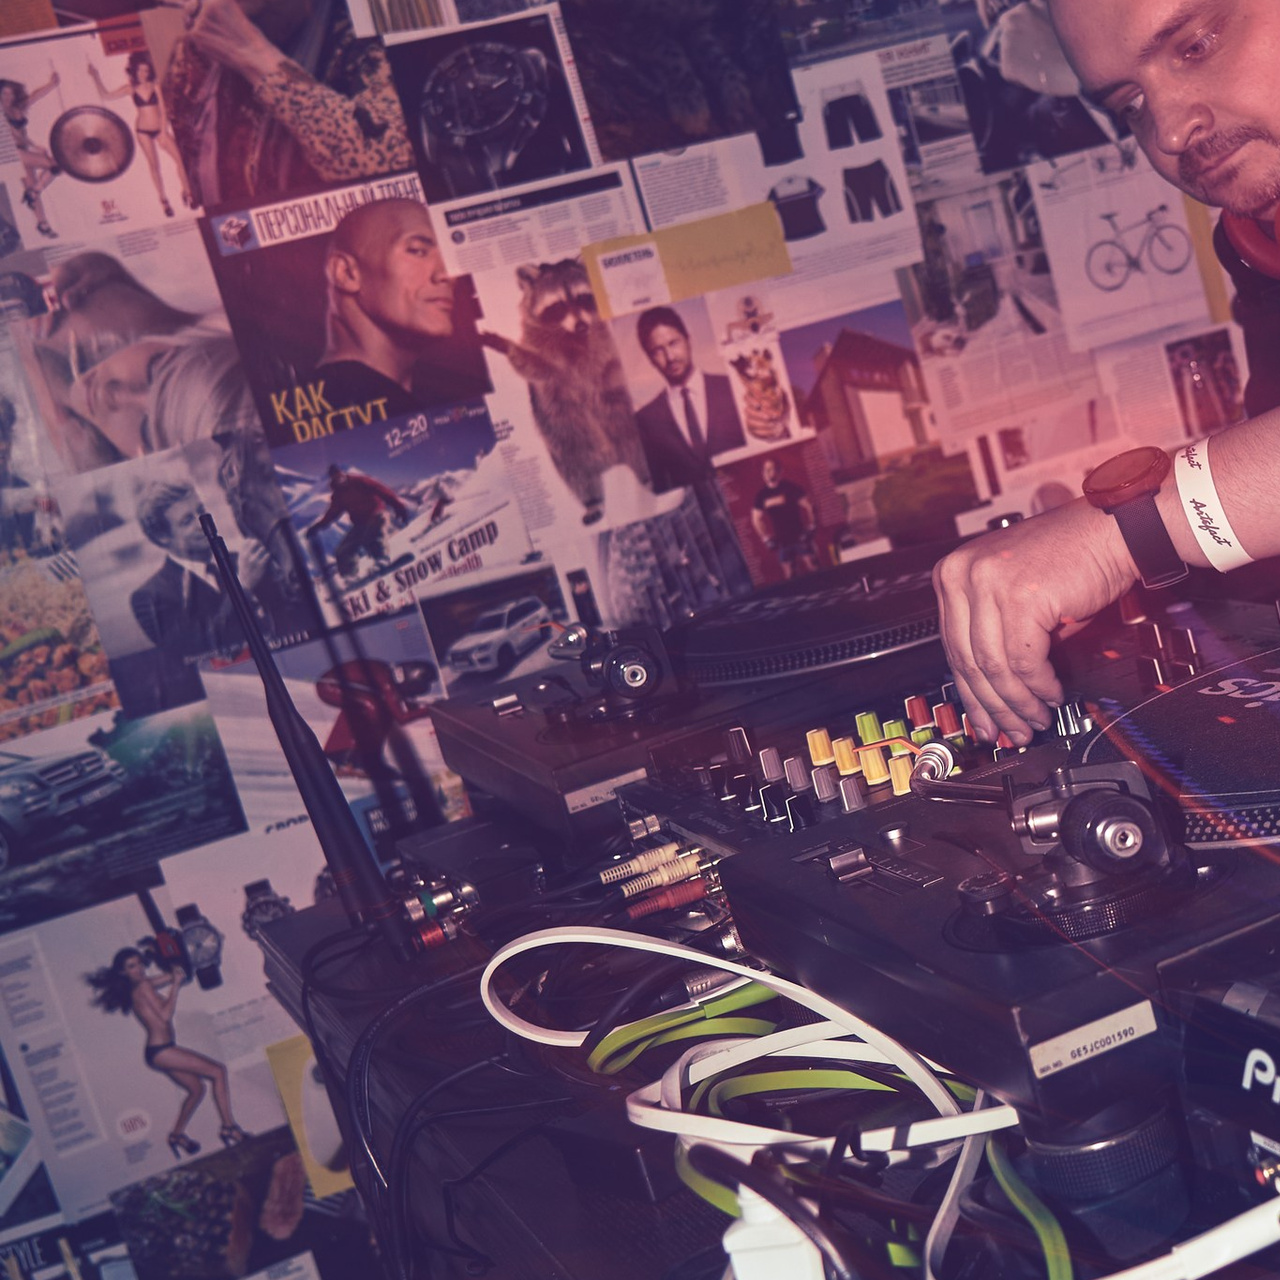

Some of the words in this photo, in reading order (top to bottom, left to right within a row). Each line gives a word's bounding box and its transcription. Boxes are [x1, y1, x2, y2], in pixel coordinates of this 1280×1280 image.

[270, 380, 333, 425] КАК
[375, 579, 391, 604] &
[394, 550, 443, 593] Snow
[447, 520, 499, 562] Camp
[1070, 1026, 1135, 1060] GE5JC001590
